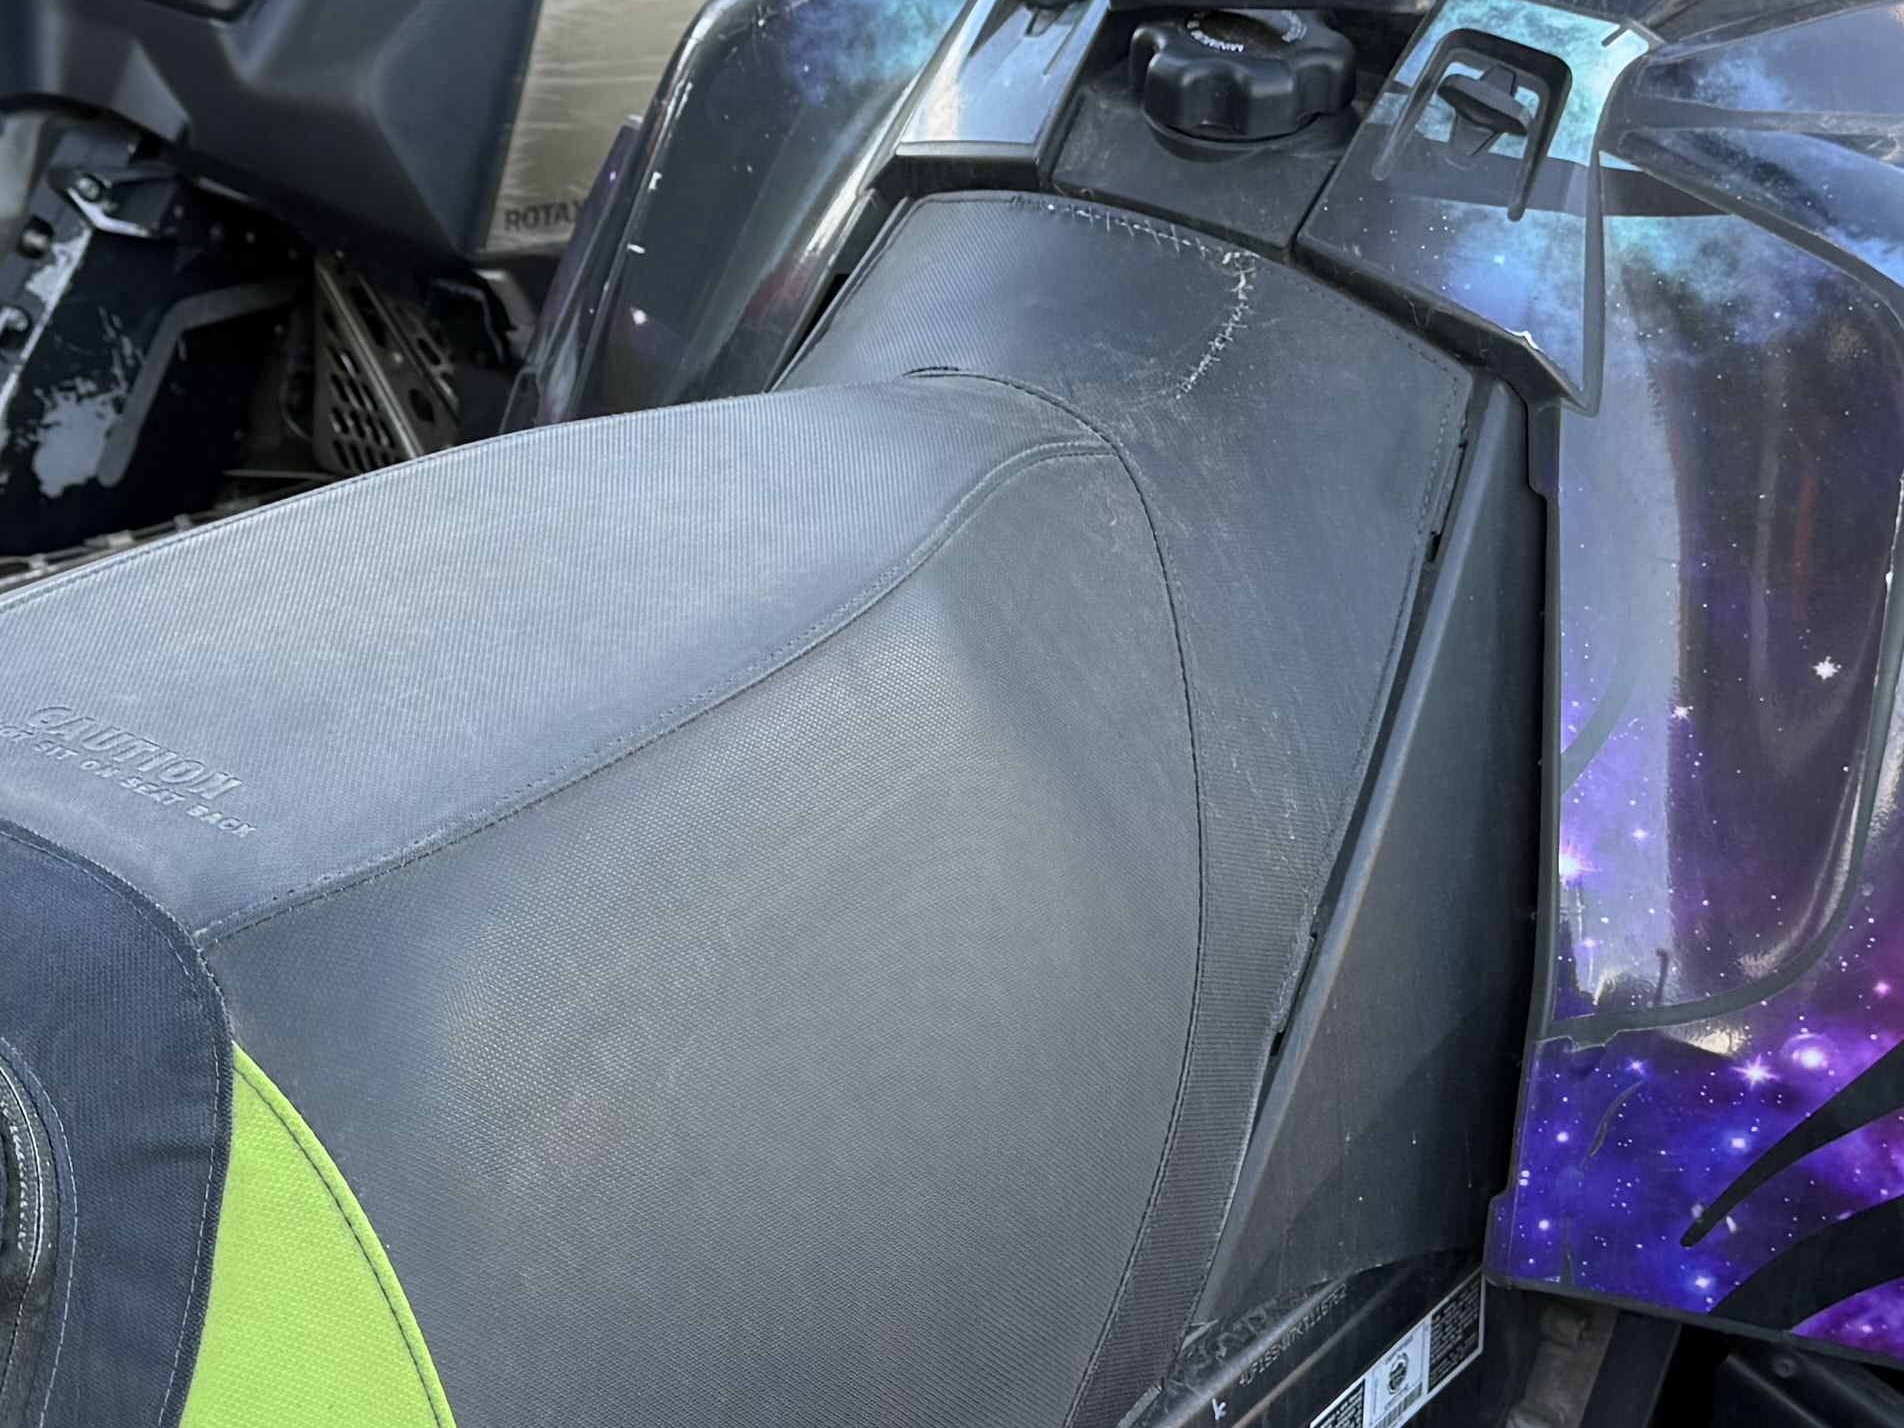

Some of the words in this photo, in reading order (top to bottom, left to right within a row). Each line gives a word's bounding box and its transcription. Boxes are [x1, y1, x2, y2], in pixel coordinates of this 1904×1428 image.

[26, 705, 243, 801] CAUTION
[31, 738, 80, 760] SIT
[79, 758, 121, 779] ON
[119, 774, 186, 805] SEAT
[186, 803, 257, 837] BACK
